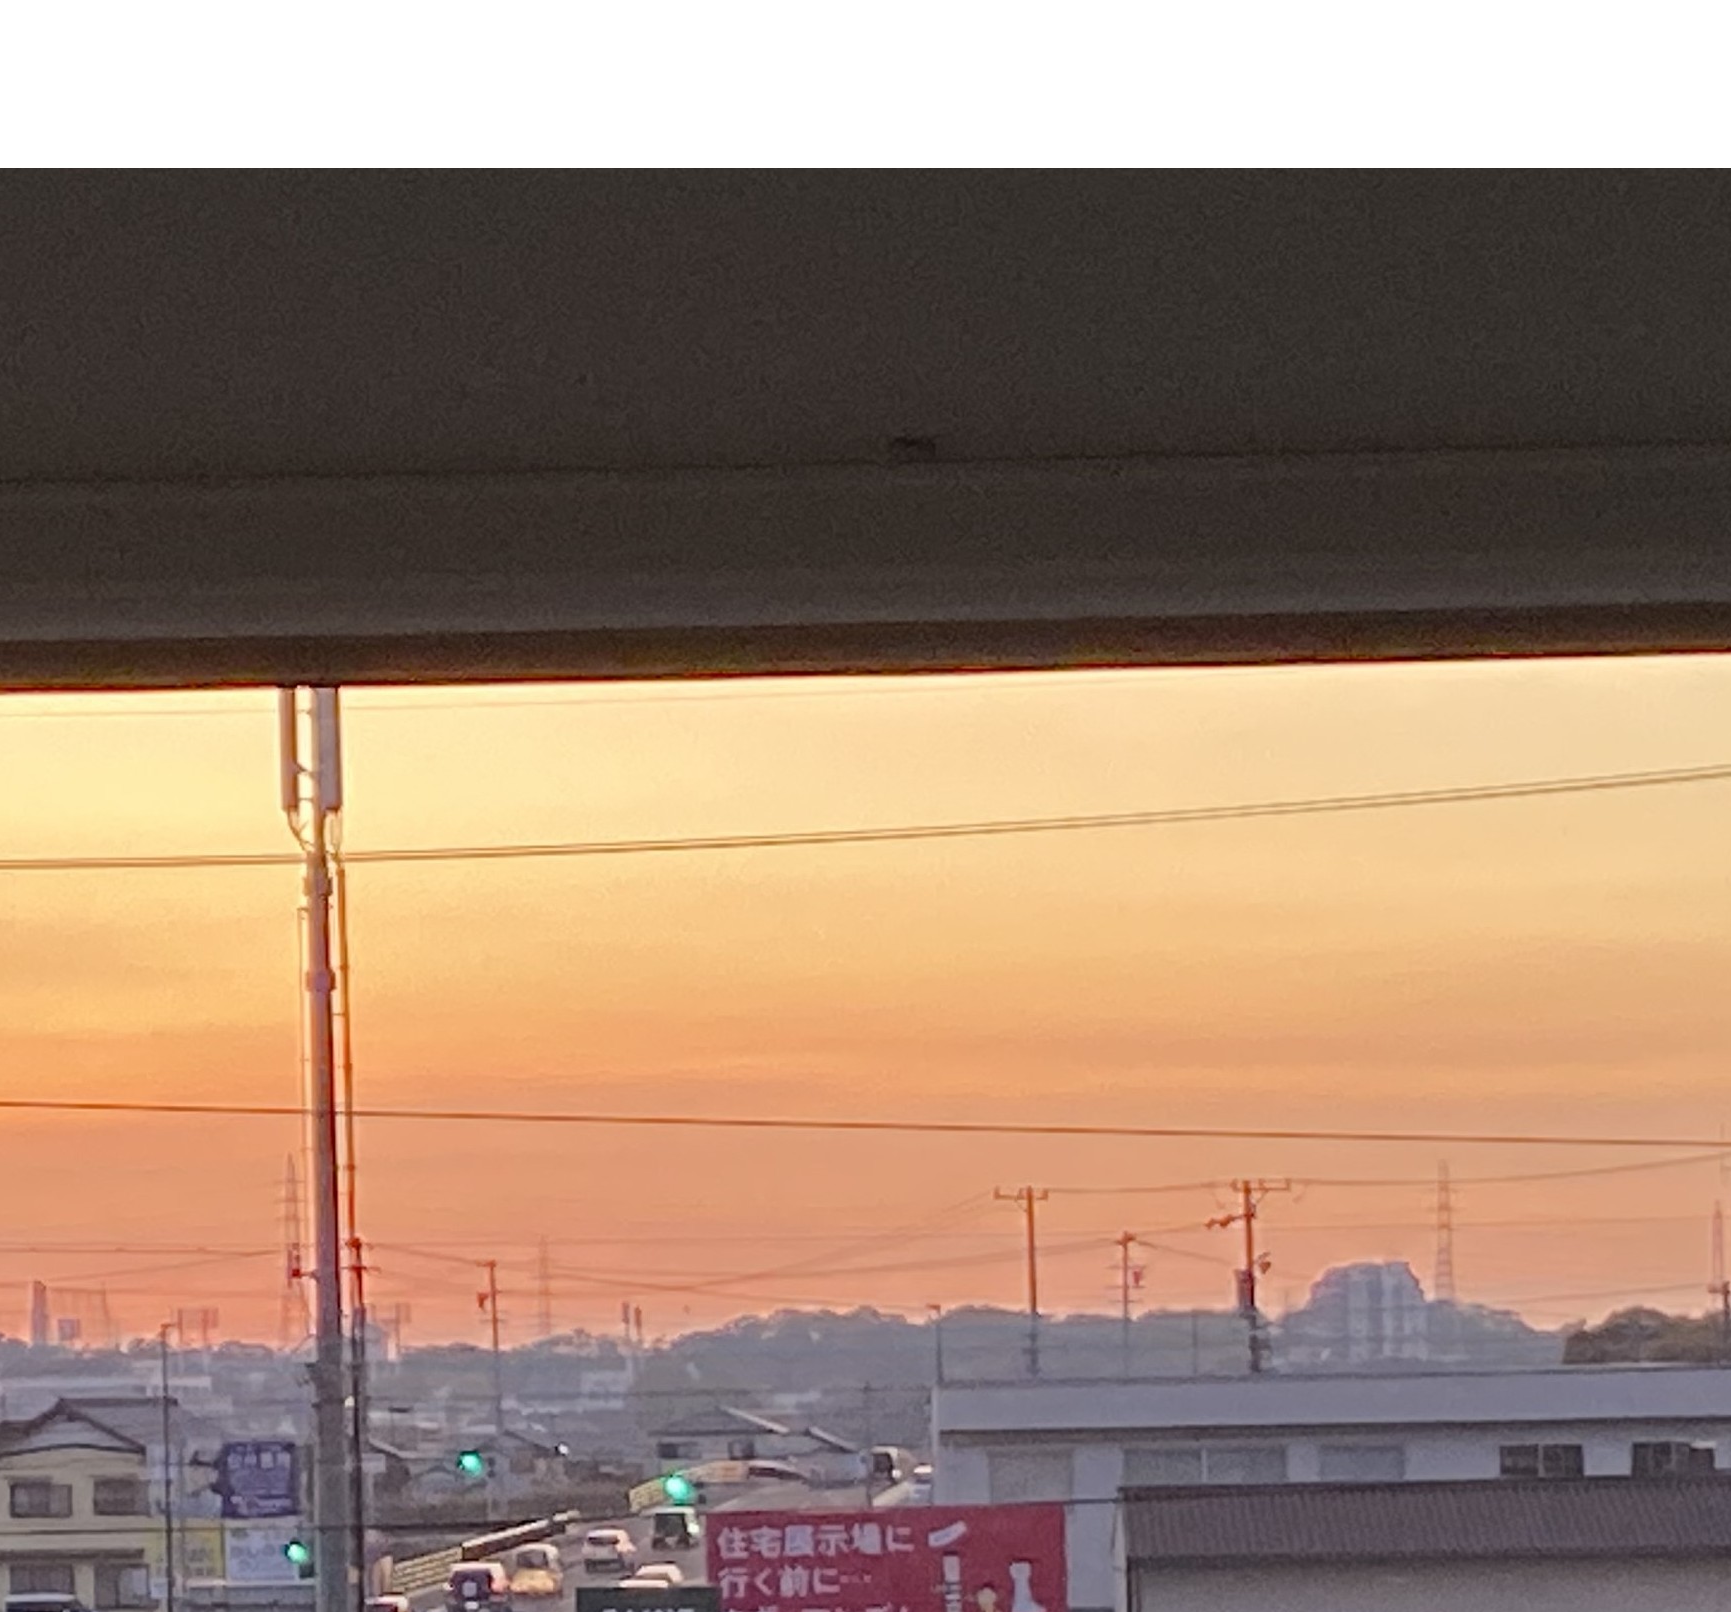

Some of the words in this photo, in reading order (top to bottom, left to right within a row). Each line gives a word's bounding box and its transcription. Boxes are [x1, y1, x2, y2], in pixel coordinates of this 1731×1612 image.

[717, 1523, 915, 1559] 住宅展示場に
